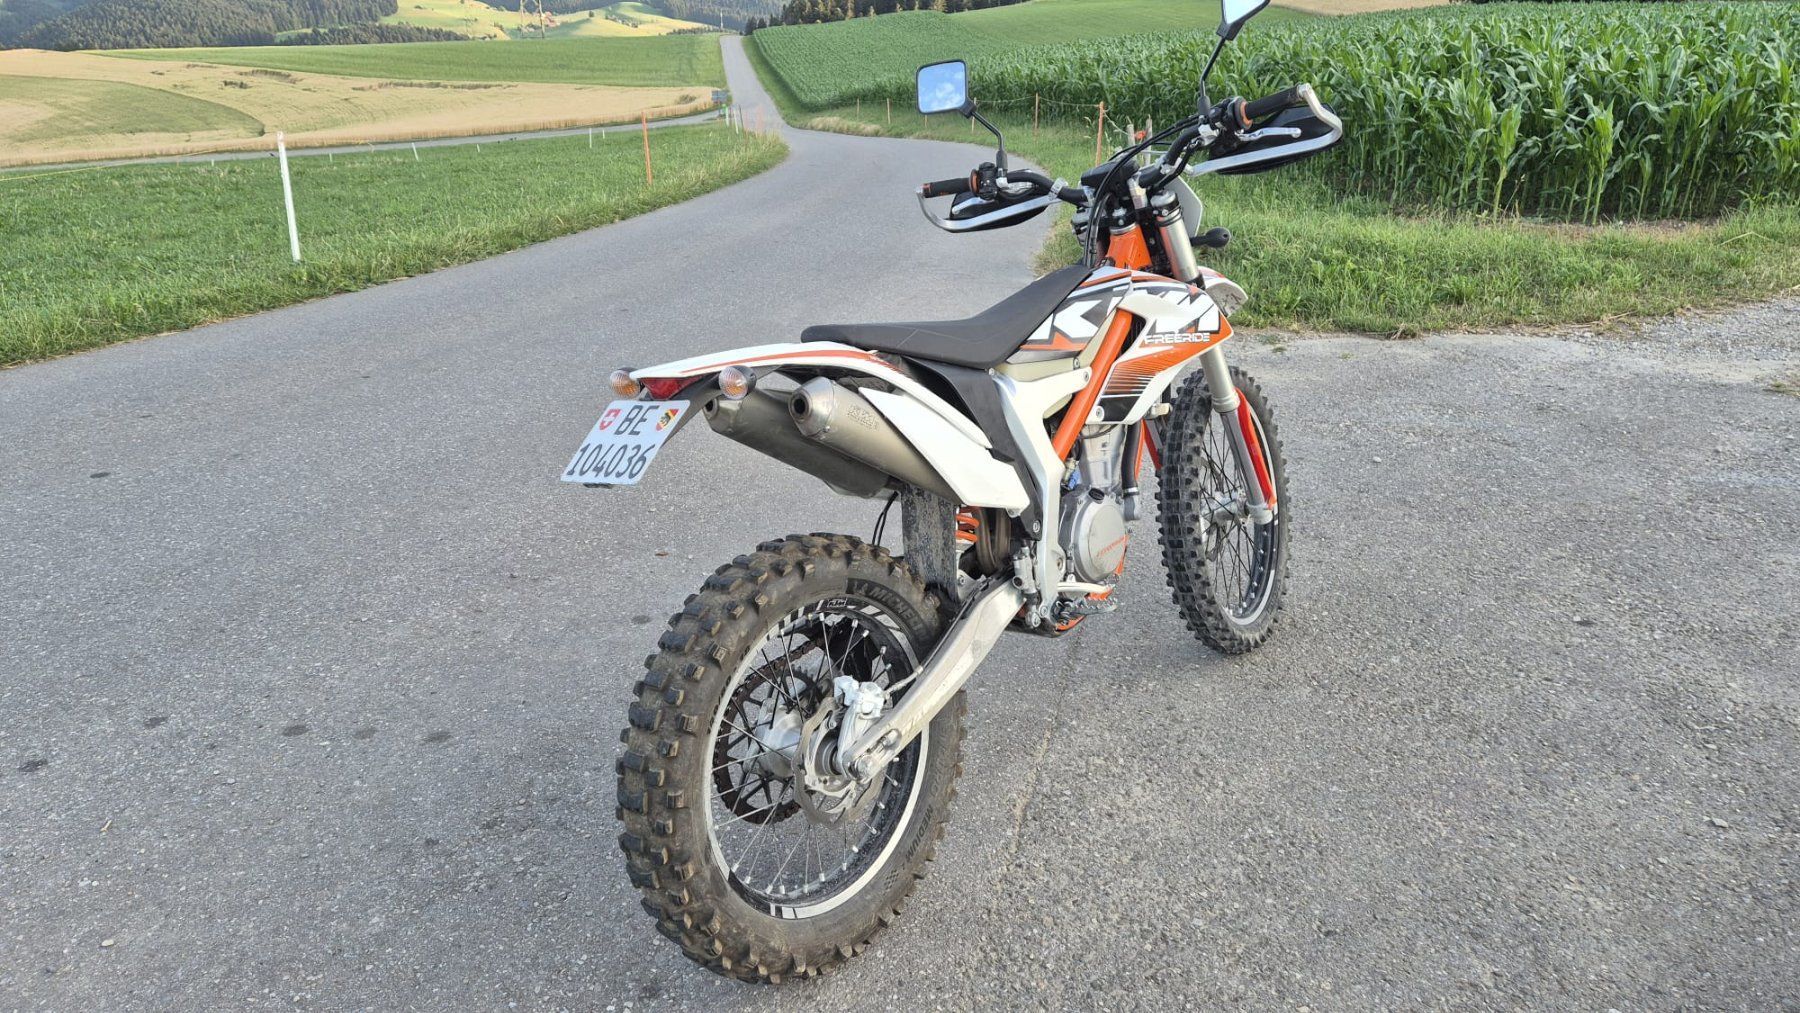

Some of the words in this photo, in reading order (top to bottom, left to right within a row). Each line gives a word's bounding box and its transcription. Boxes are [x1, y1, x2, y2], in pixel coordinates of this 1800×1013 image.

[1144, 332, 1211, 344] FREERIDE
[614, 405, 660, 436] BE
[566, 443, 656, 480] 104036
[905, 804, 934, 862] MEDIUM
